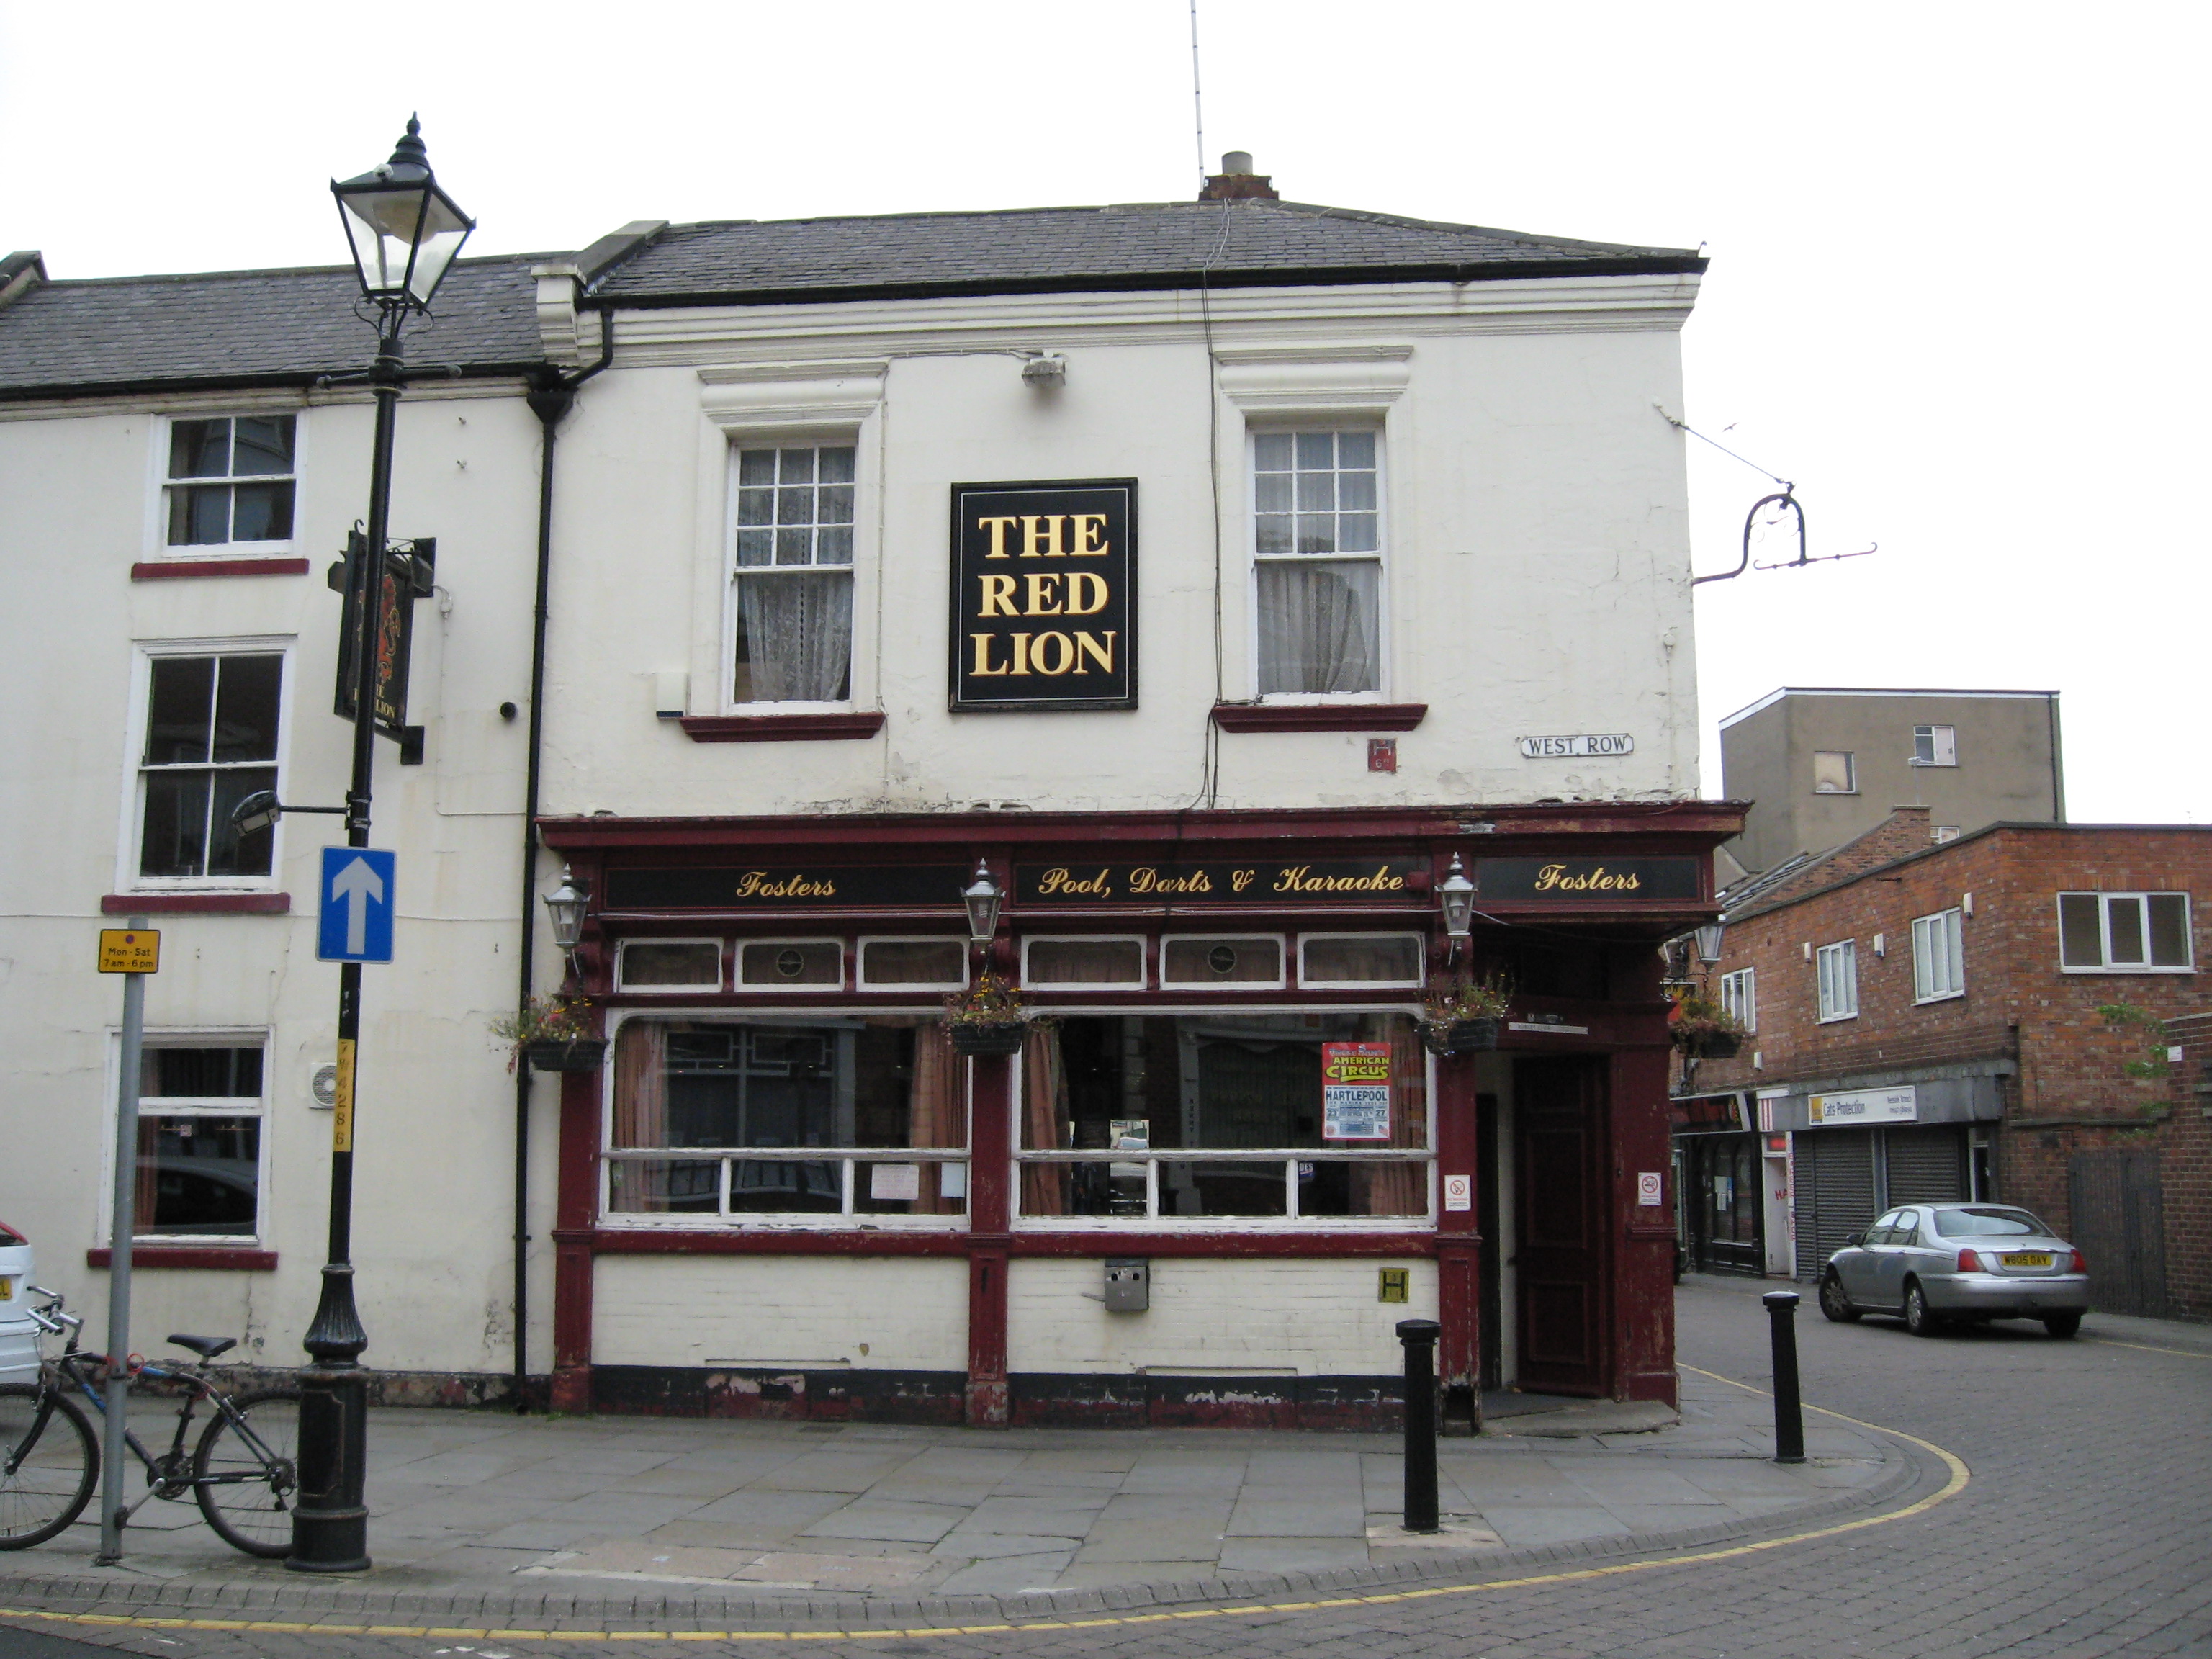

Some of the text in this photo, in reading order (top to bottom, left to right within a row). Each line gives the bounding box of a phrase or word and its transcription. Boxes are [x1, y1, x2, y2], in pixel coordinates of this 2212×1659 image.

[978, 513, 1110, 559] THE
[976, 572, 1110, 617] RED
[968, 631, 1117, 676] LION
[1528, 736, 1626, 755] WEST ROW
[736, 871, 837, 897] Fosters
[1038, 865, 1405, 899] Pool, Darts & Karaoke
[1534, 864, 1641, 891] Fosters
[108, 948, 127, 956] Mon
[135, 948, 150, 956] Sat
[1326, 1066, 1389, 1082] CIRCUS
[1326, 1090, 1388, 1101] HARTLEPOOL
[1824, 1102, 1835, 1116] Cats
[1837, 1099, 1866, 1115] Protection
[1383, 1272, 1406, 1298] H
